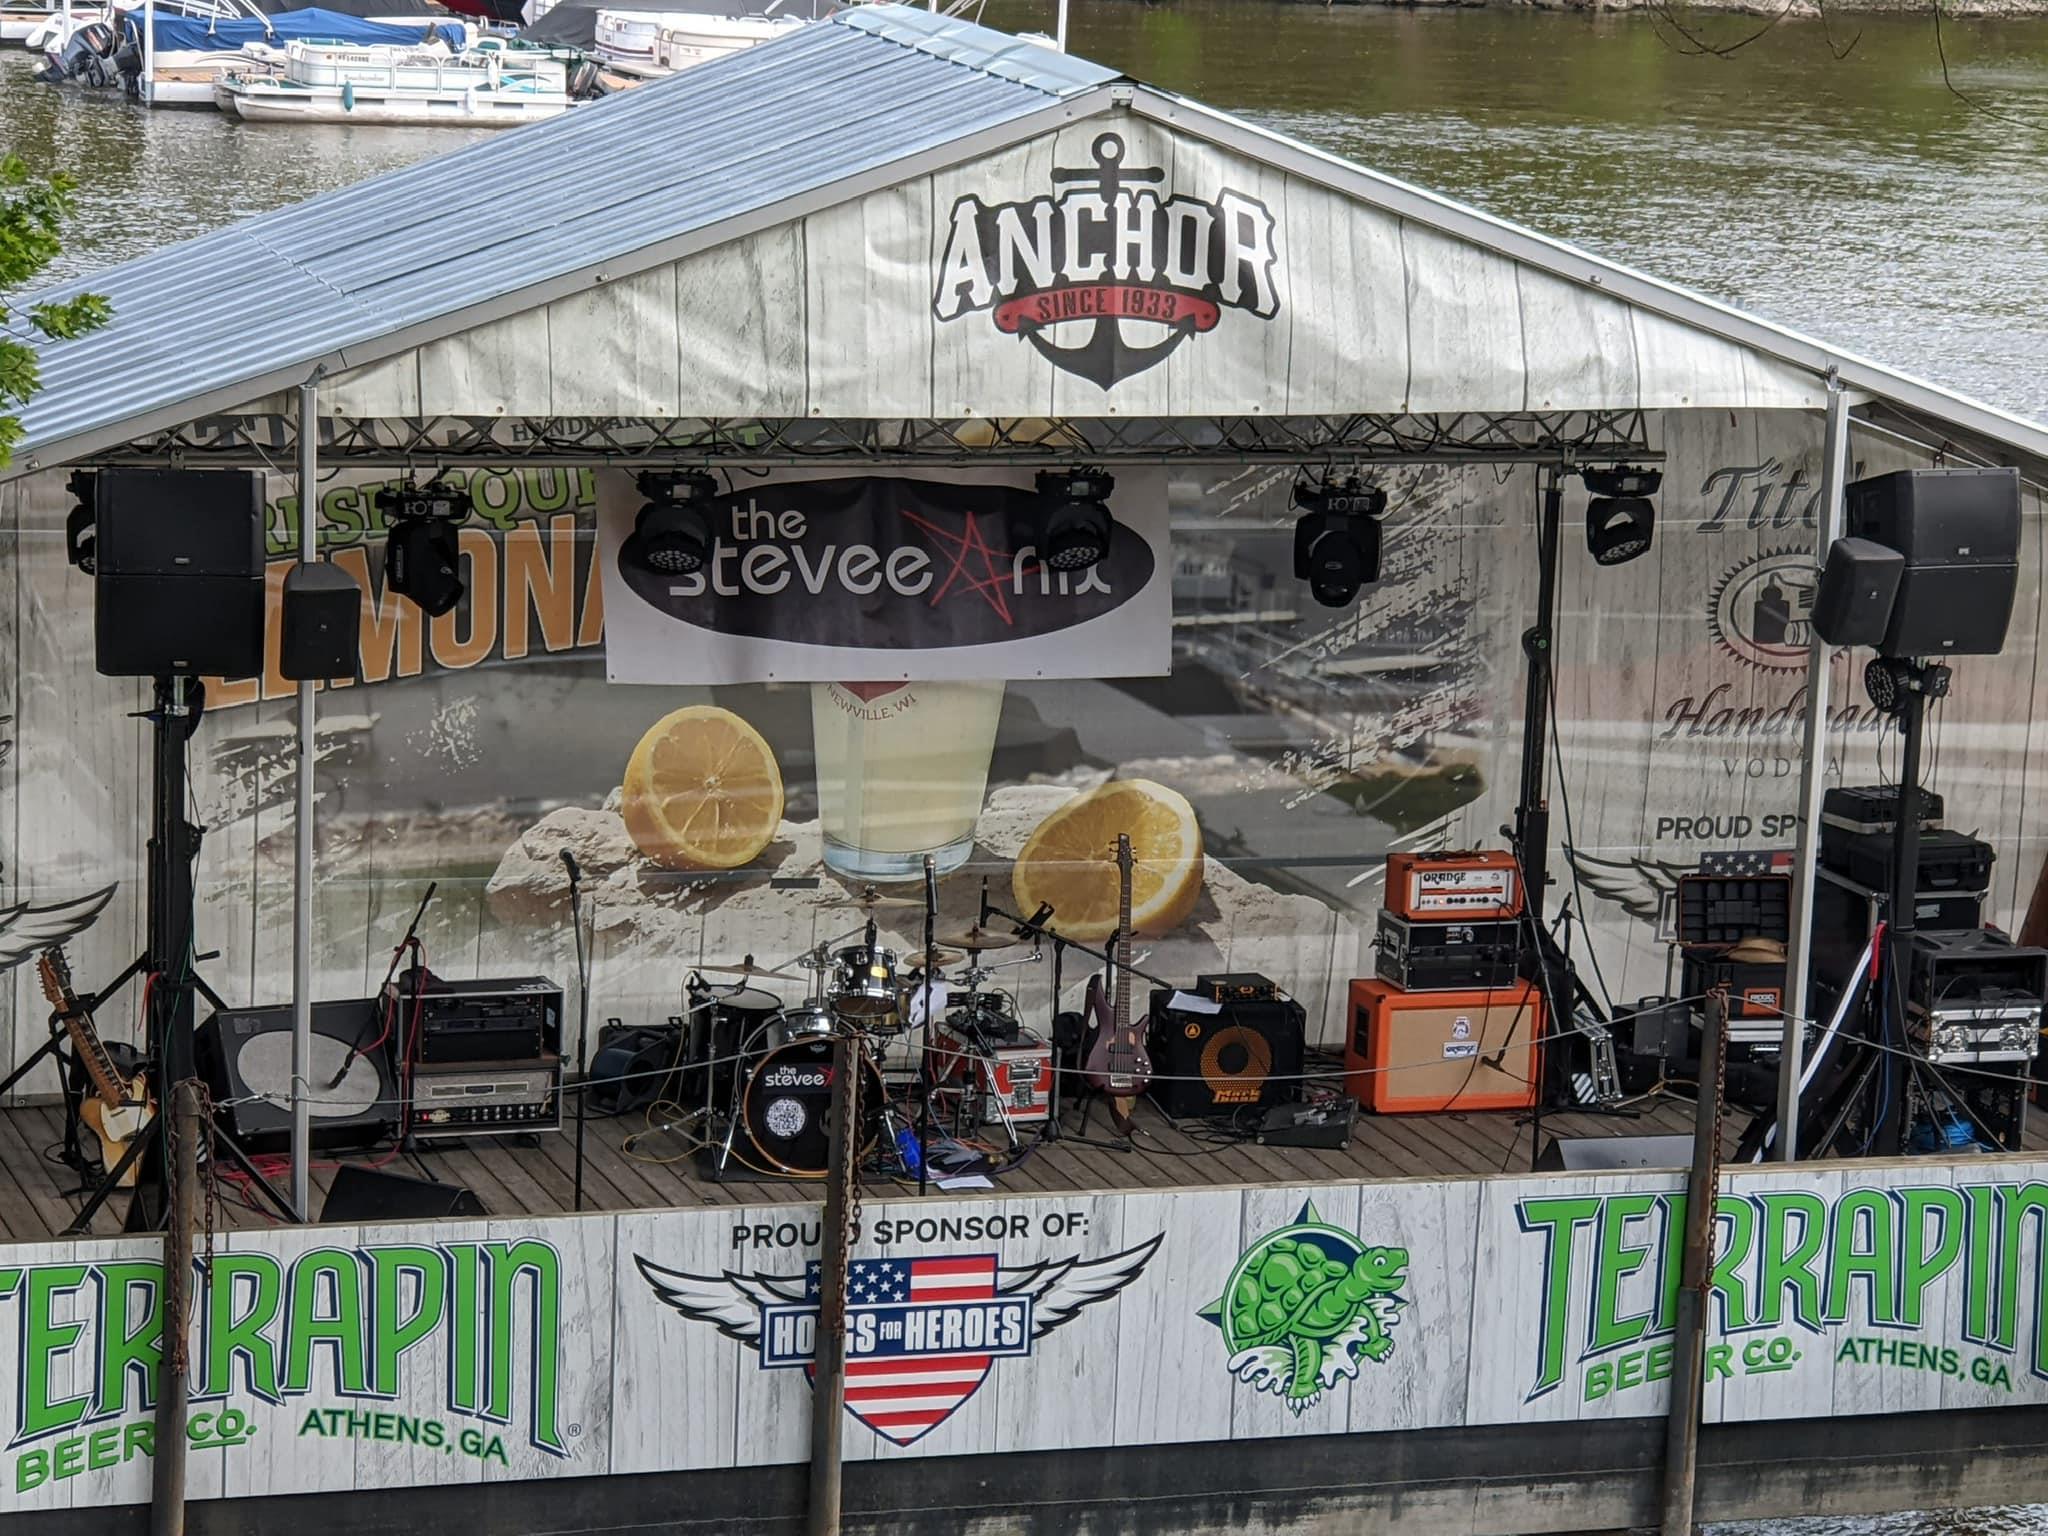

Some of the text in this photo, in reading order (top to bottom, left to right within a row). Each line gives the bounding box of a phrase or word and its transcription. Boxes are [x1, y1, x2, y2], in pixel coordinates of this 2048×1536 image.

[935, 188, 1279, 320] ANCHOR
[1036, 288, 1178, 321] SINCE 1933
[731, 499, 808, 541] the
[826, 682, 918, 721] NEWVILLE, WI
[1722, 756, 1843, 779] VODA
[1655, 815, 1753, 841] PROUD
[765, 1073, 825, 1087] stevee
[780, 1065, 797, 1075] the
[873, 1214, 1030, 1246] SPONSOR
[1042, 1211, 1090, 1238] OF:
[0, 1237, 572, 1458] ERRAPIN
[879, 1319, 902, 1341] FOR
[904, 1304, 1022, 1351] HEROES
[1584, 1336, 1803, 1402] BEER CO.
[1836, 1337, 2013, 1393] ATHENS, GA
[16, 1408, 258, 1494] BEER CO.
[298, 1408, 510, 1467] ATHENS, GA
